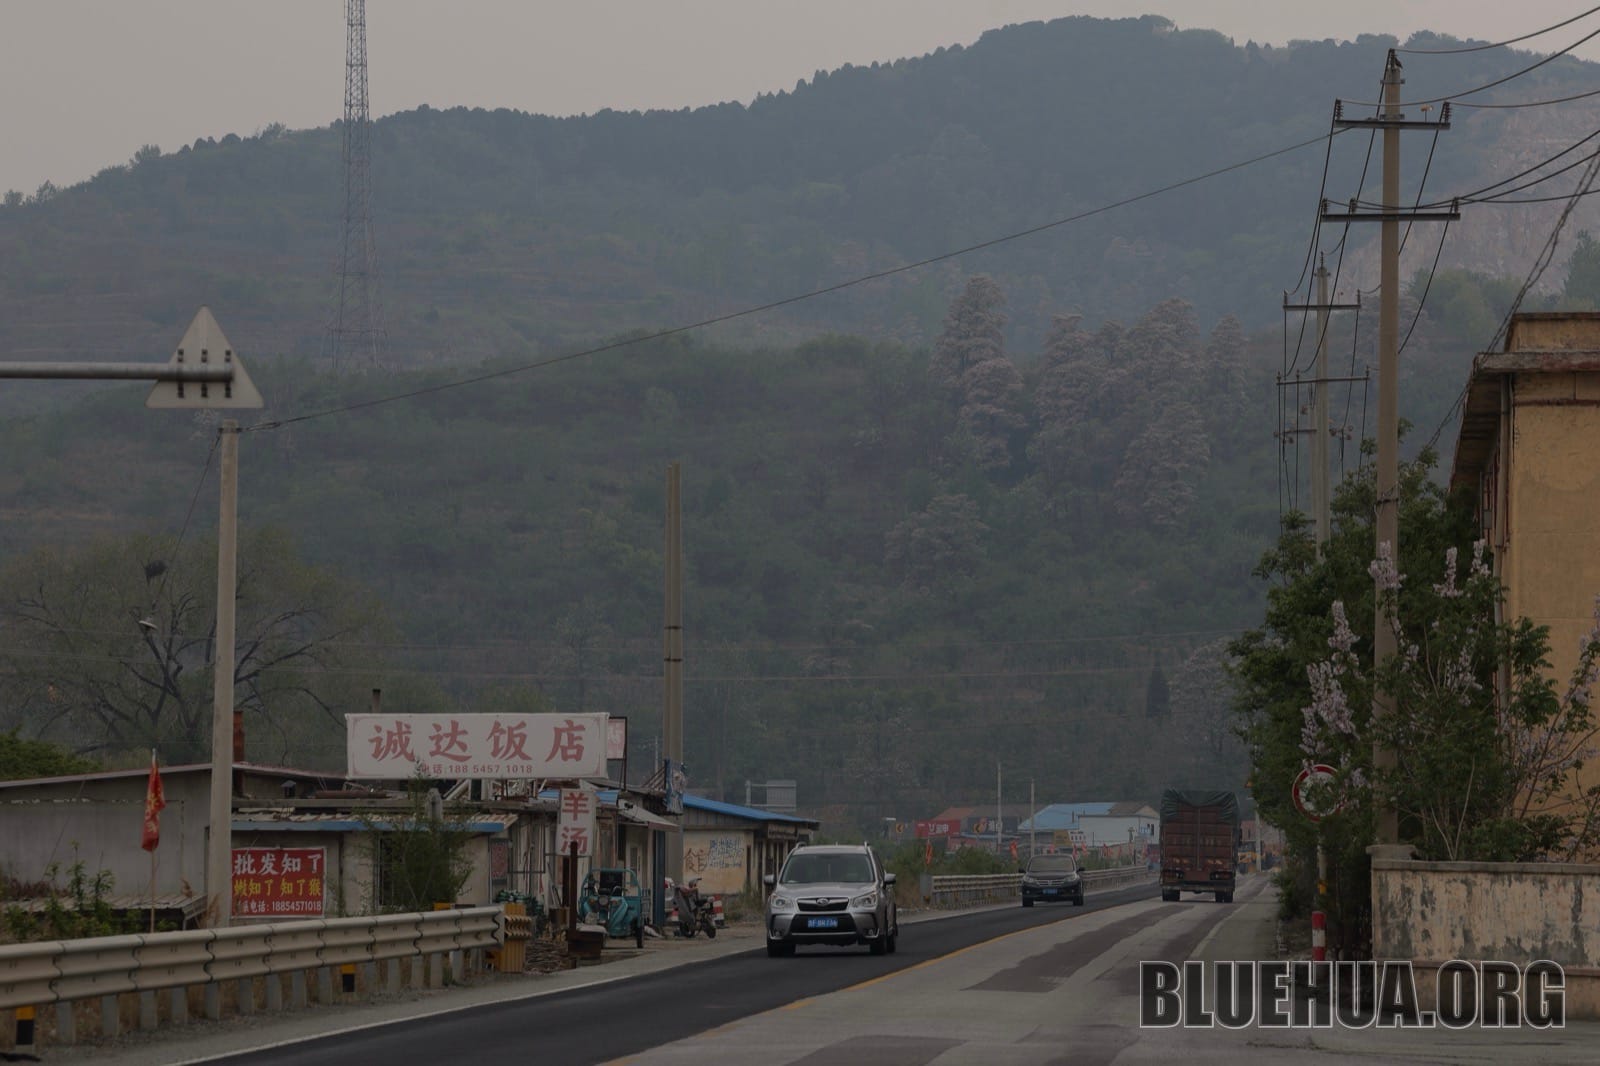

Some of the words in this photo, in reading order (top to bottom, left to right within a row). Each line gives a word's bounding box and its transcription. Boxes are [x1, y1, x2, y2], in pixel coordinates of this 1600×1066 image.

[368, 719, 586, 762] 诚达饭店
[473, 765, 501, 774] 5457
[506, 765, 533, 774] 1018
[561, 792, 589, 854] 羊汤
[232, 852, 322, 875] 批发知了
